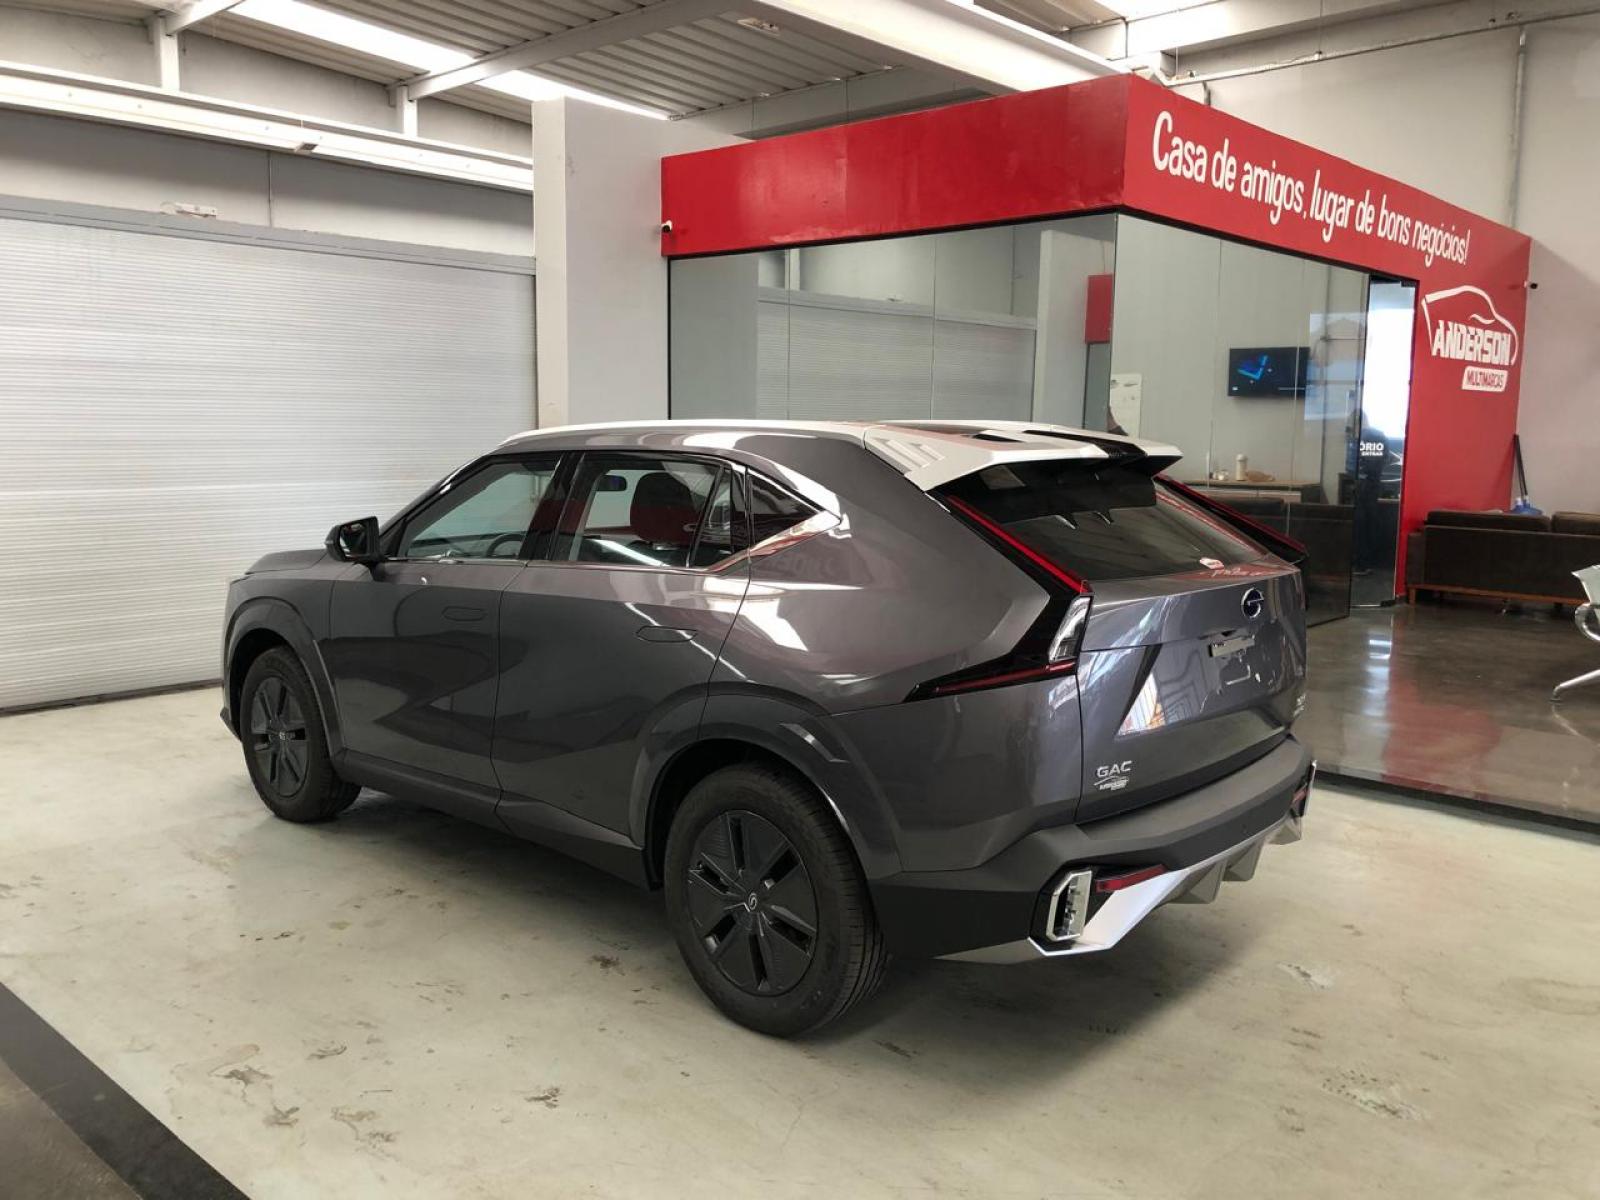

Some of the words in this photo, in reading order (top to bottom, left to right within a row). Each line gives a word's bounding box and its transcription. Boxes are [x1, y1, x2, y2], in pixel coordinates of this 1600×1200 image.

[1153, 111, 1208, 183] Casa
[1211, 138, 1238, 192] de
[1241, 160, 1307, 225] amigos,
[1309, 169, 1355, 243] lugar
[1355, 190, 1375, 235] de
[1377, 194, 1411, 246] bons
[1412, 219, 1471, 268] negócios!
[1431, 319, 1511, 366] ANDERSON
[1096, 760, 1132, 777] GAC
